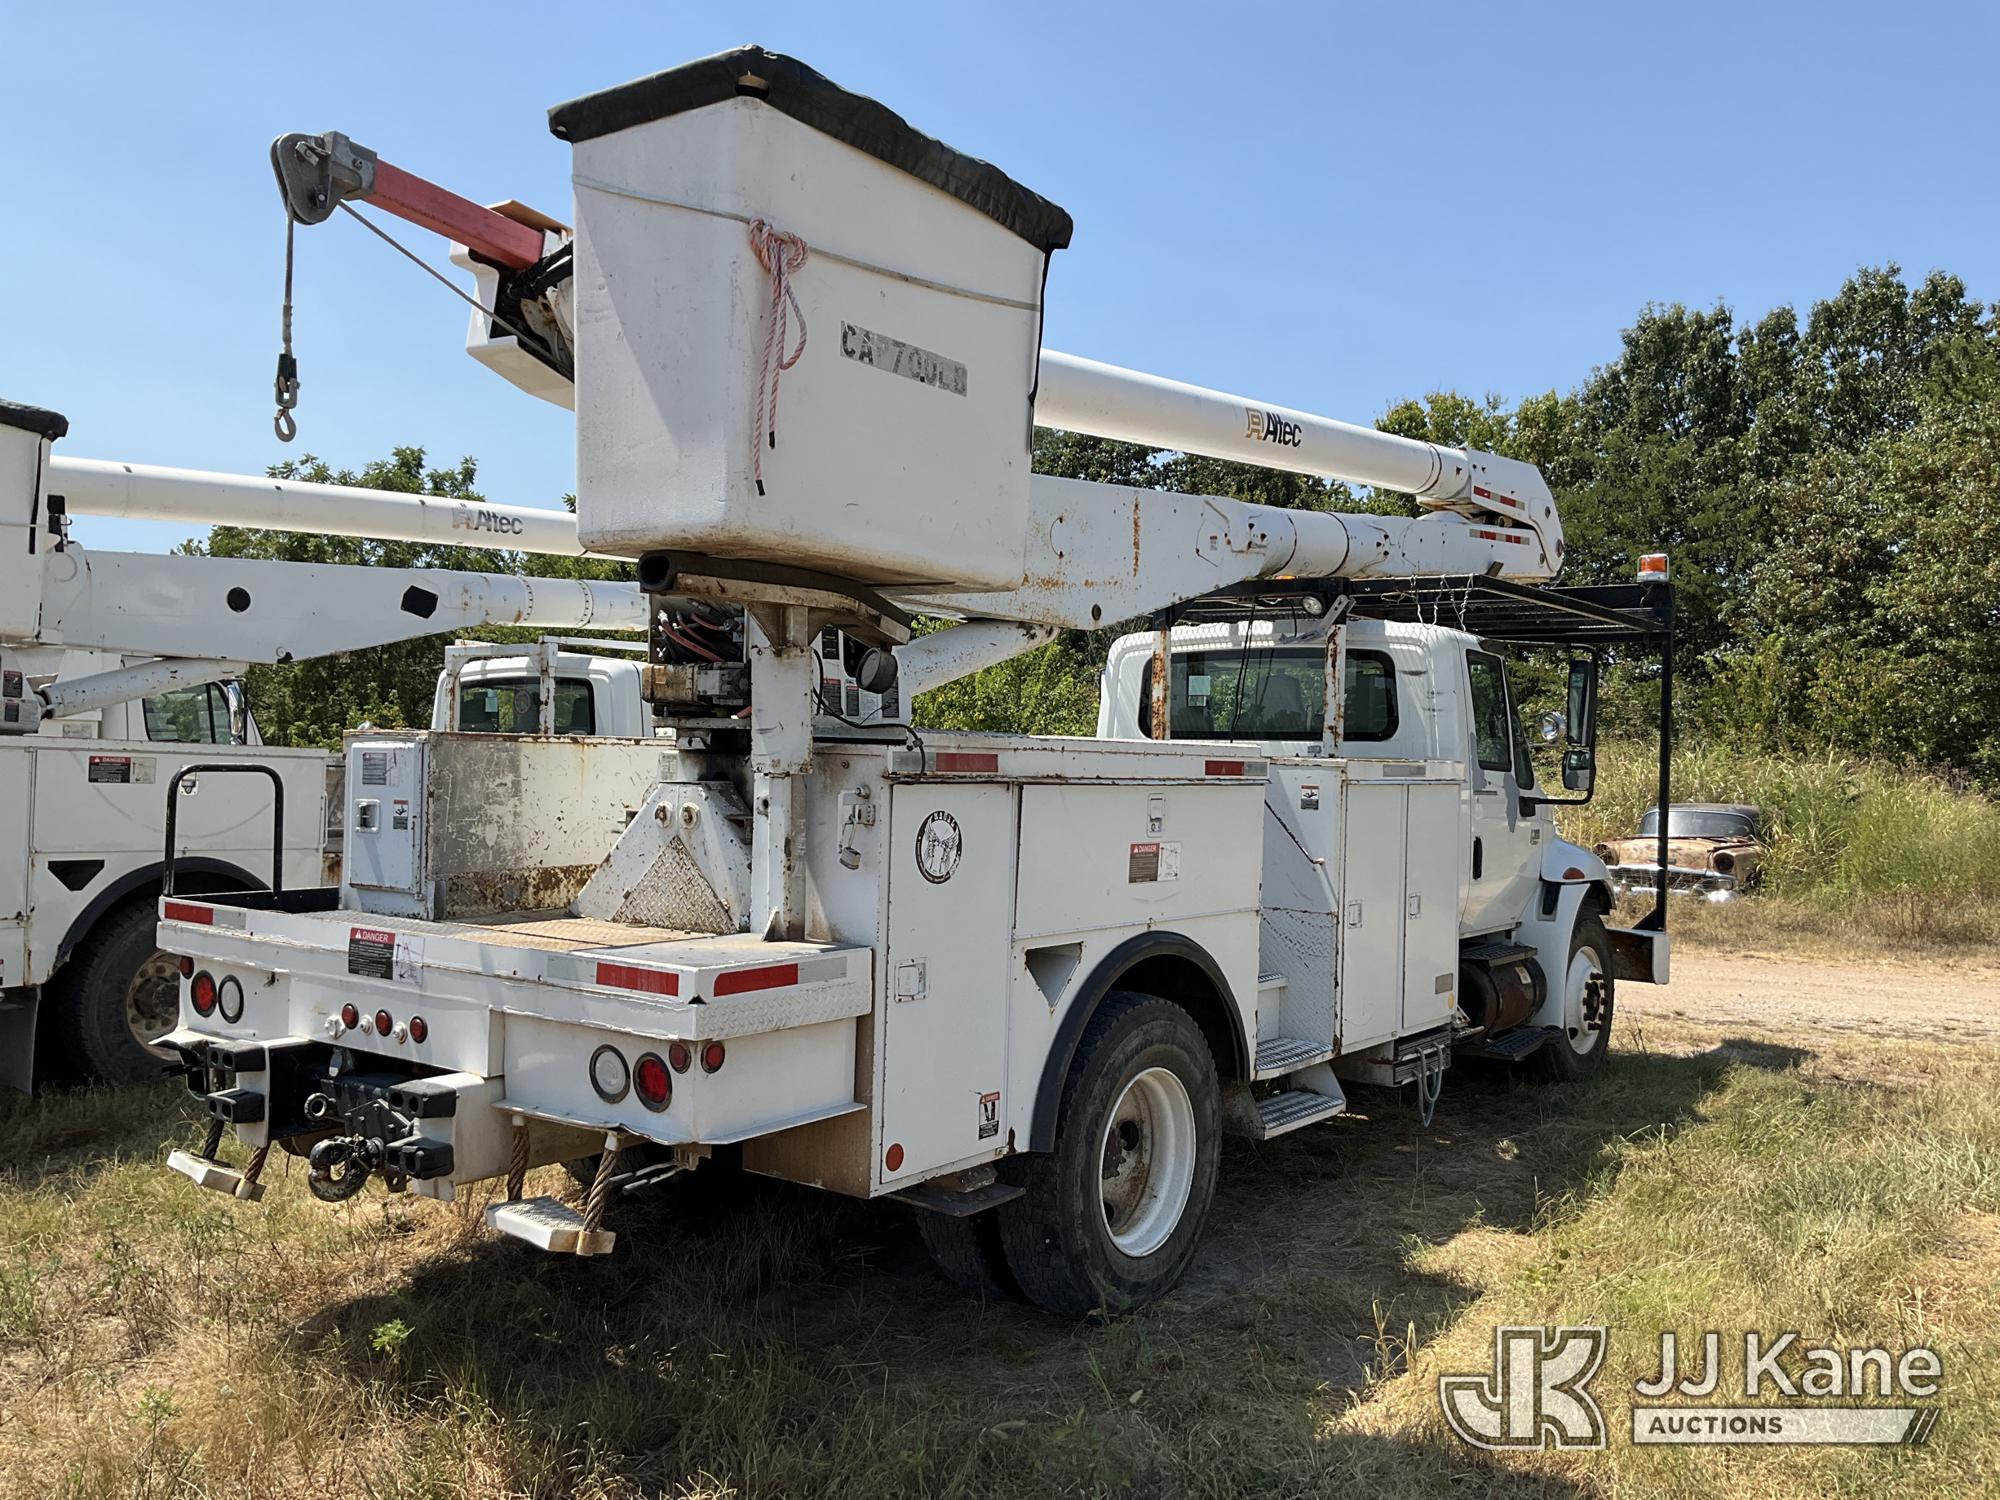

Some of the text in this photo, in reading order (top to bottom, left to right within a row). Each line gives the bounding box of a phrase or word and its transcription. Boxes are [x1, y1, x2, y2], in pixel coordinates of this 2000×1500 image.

[1263, 411, 1302, 447] Altec
[474, 509, 523, 535] Altec
[362, 930, 389, 943] DANGER
